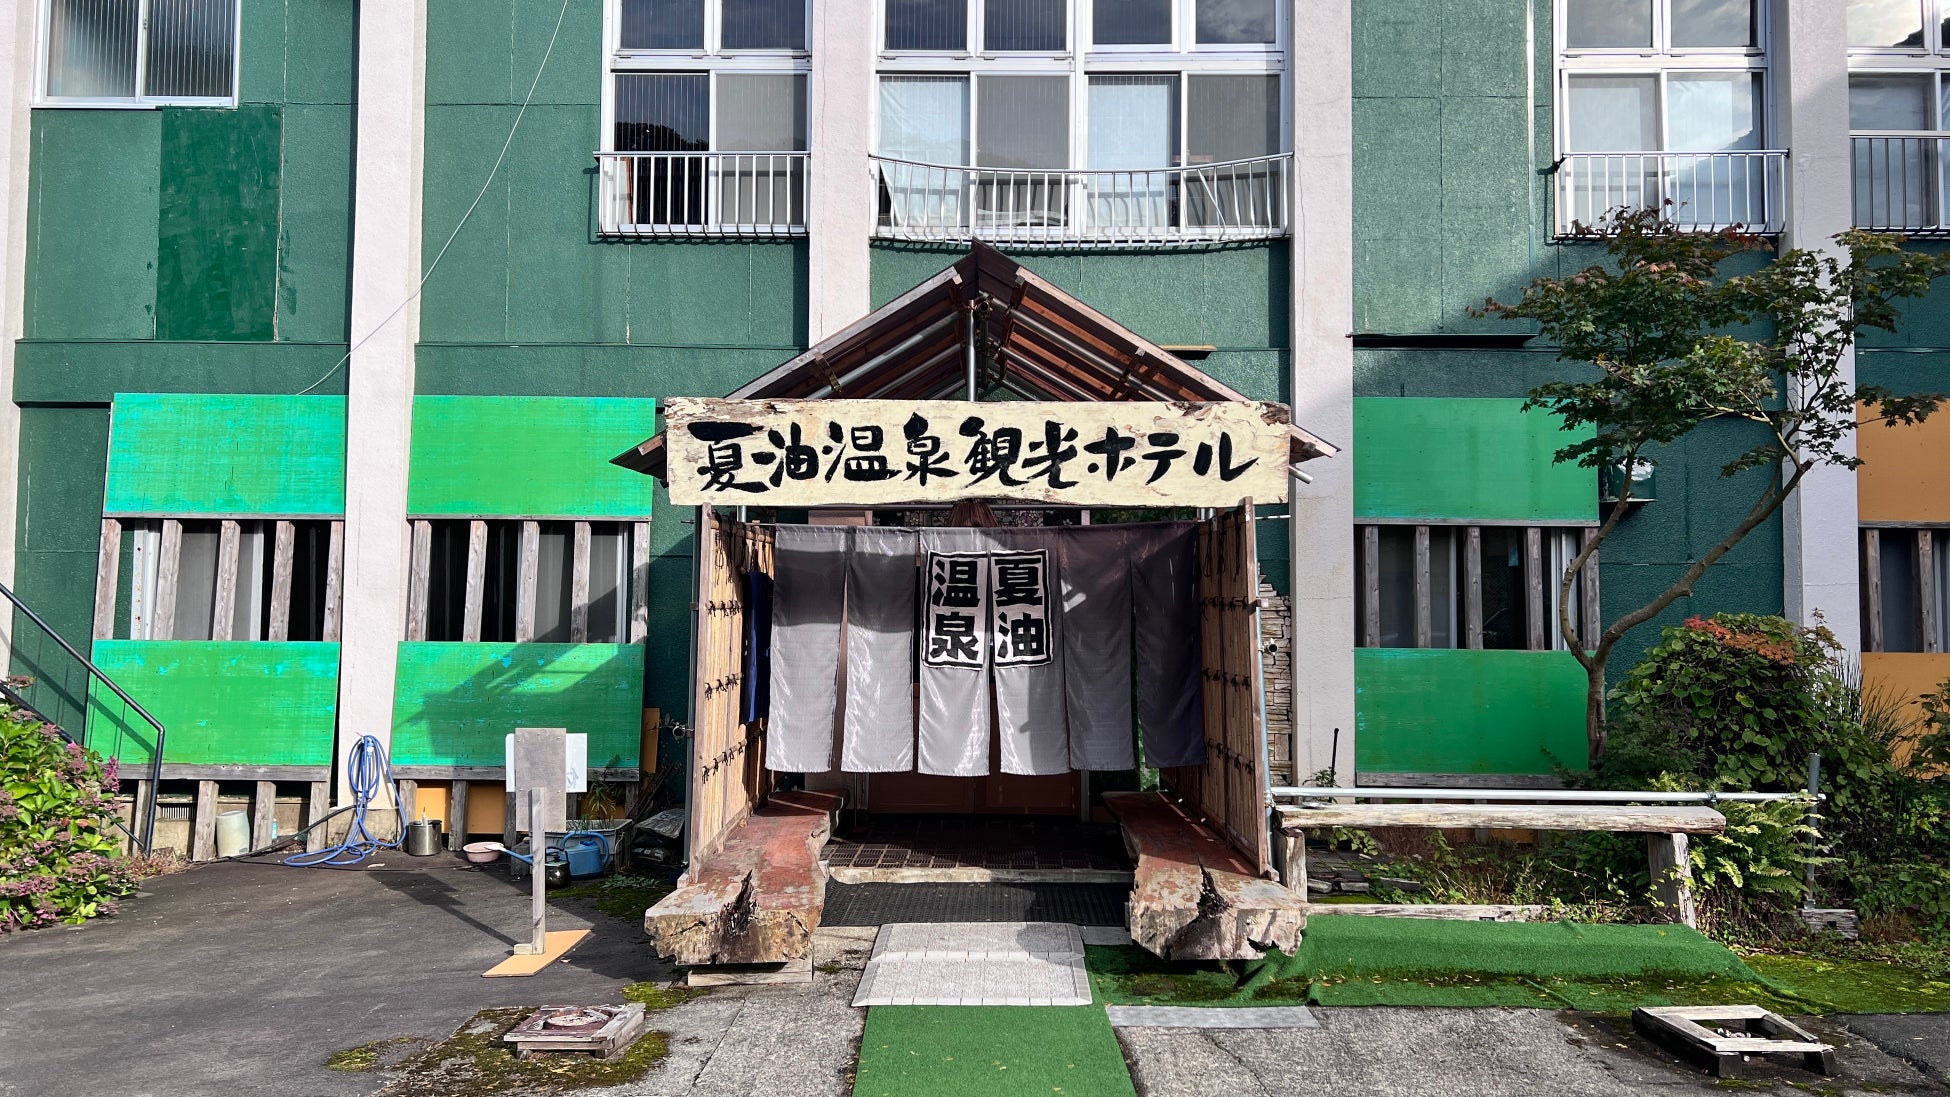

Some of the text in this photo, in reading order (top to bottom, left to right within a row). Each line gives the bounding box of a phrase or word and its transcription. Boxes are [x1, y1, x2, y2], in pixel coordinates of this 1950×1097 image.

[687, 411, 1258, 494] 夏油温泉観光ホテル
[930, 559, 980, 661] 温泉
[994, 558, 1044, 658] 夏油
